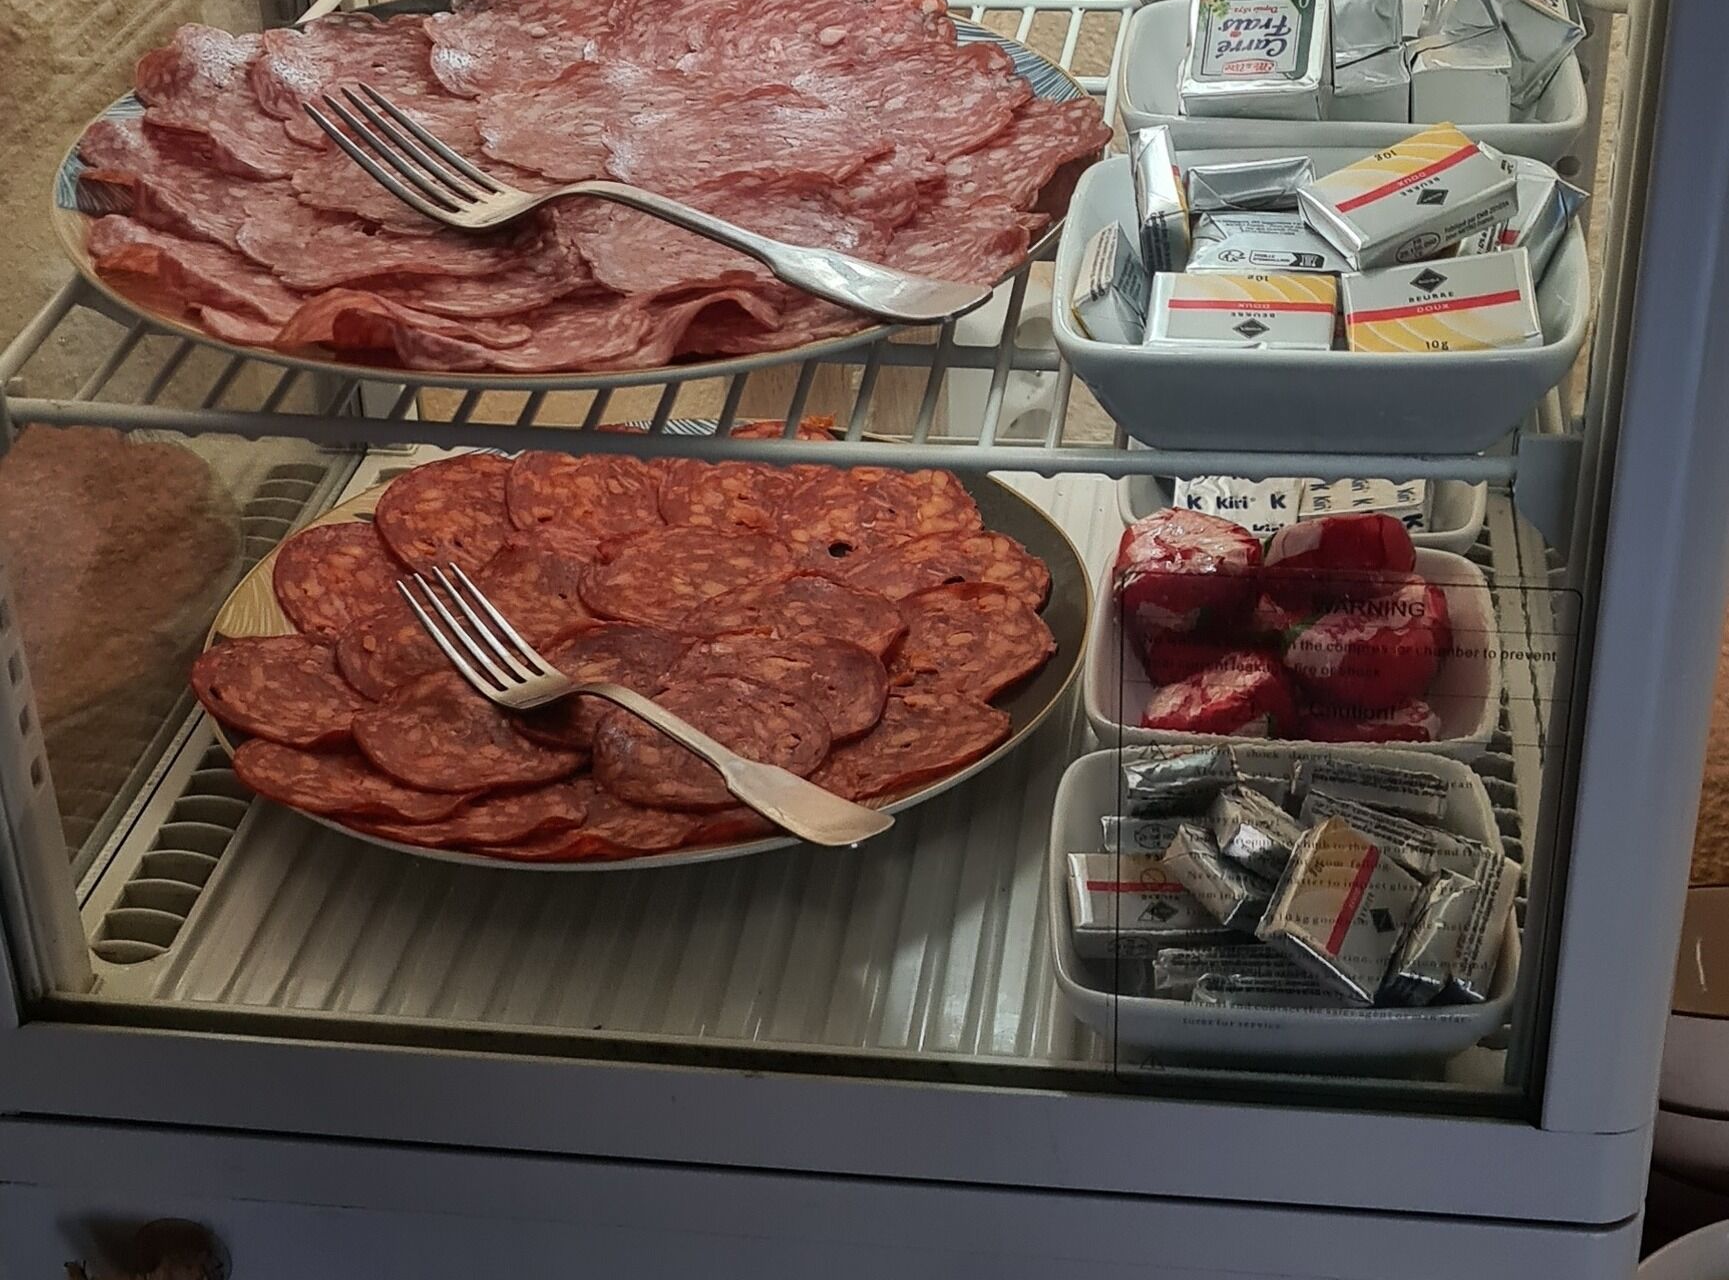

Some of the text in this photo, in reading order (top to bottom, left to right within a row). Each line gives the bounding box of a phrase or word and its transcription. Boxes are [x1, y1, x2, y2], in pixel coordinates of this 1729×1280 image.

[1222, 15, 1291, 38] Frais
[1215, 38, 1288, 59] Carré
[1374, 149, 1398, 163] 10g
[1396, 171, 1427, 187] DOUX
[1400, 176, 1441, 197] BEURRE
[1408, 291, 1454, 303] BEURRE
[1416, 303, 1450, 313] DOUX
[1425, 340, 1449, 351] 10g
[1187, 494, 1202, 510] K
[1270, 493, 1287, 509] K
[1314, 598, 1426, 619] WARNING
[1483, 649, 1497, 659] to
[1501, 650, 1557, 663] prevent
